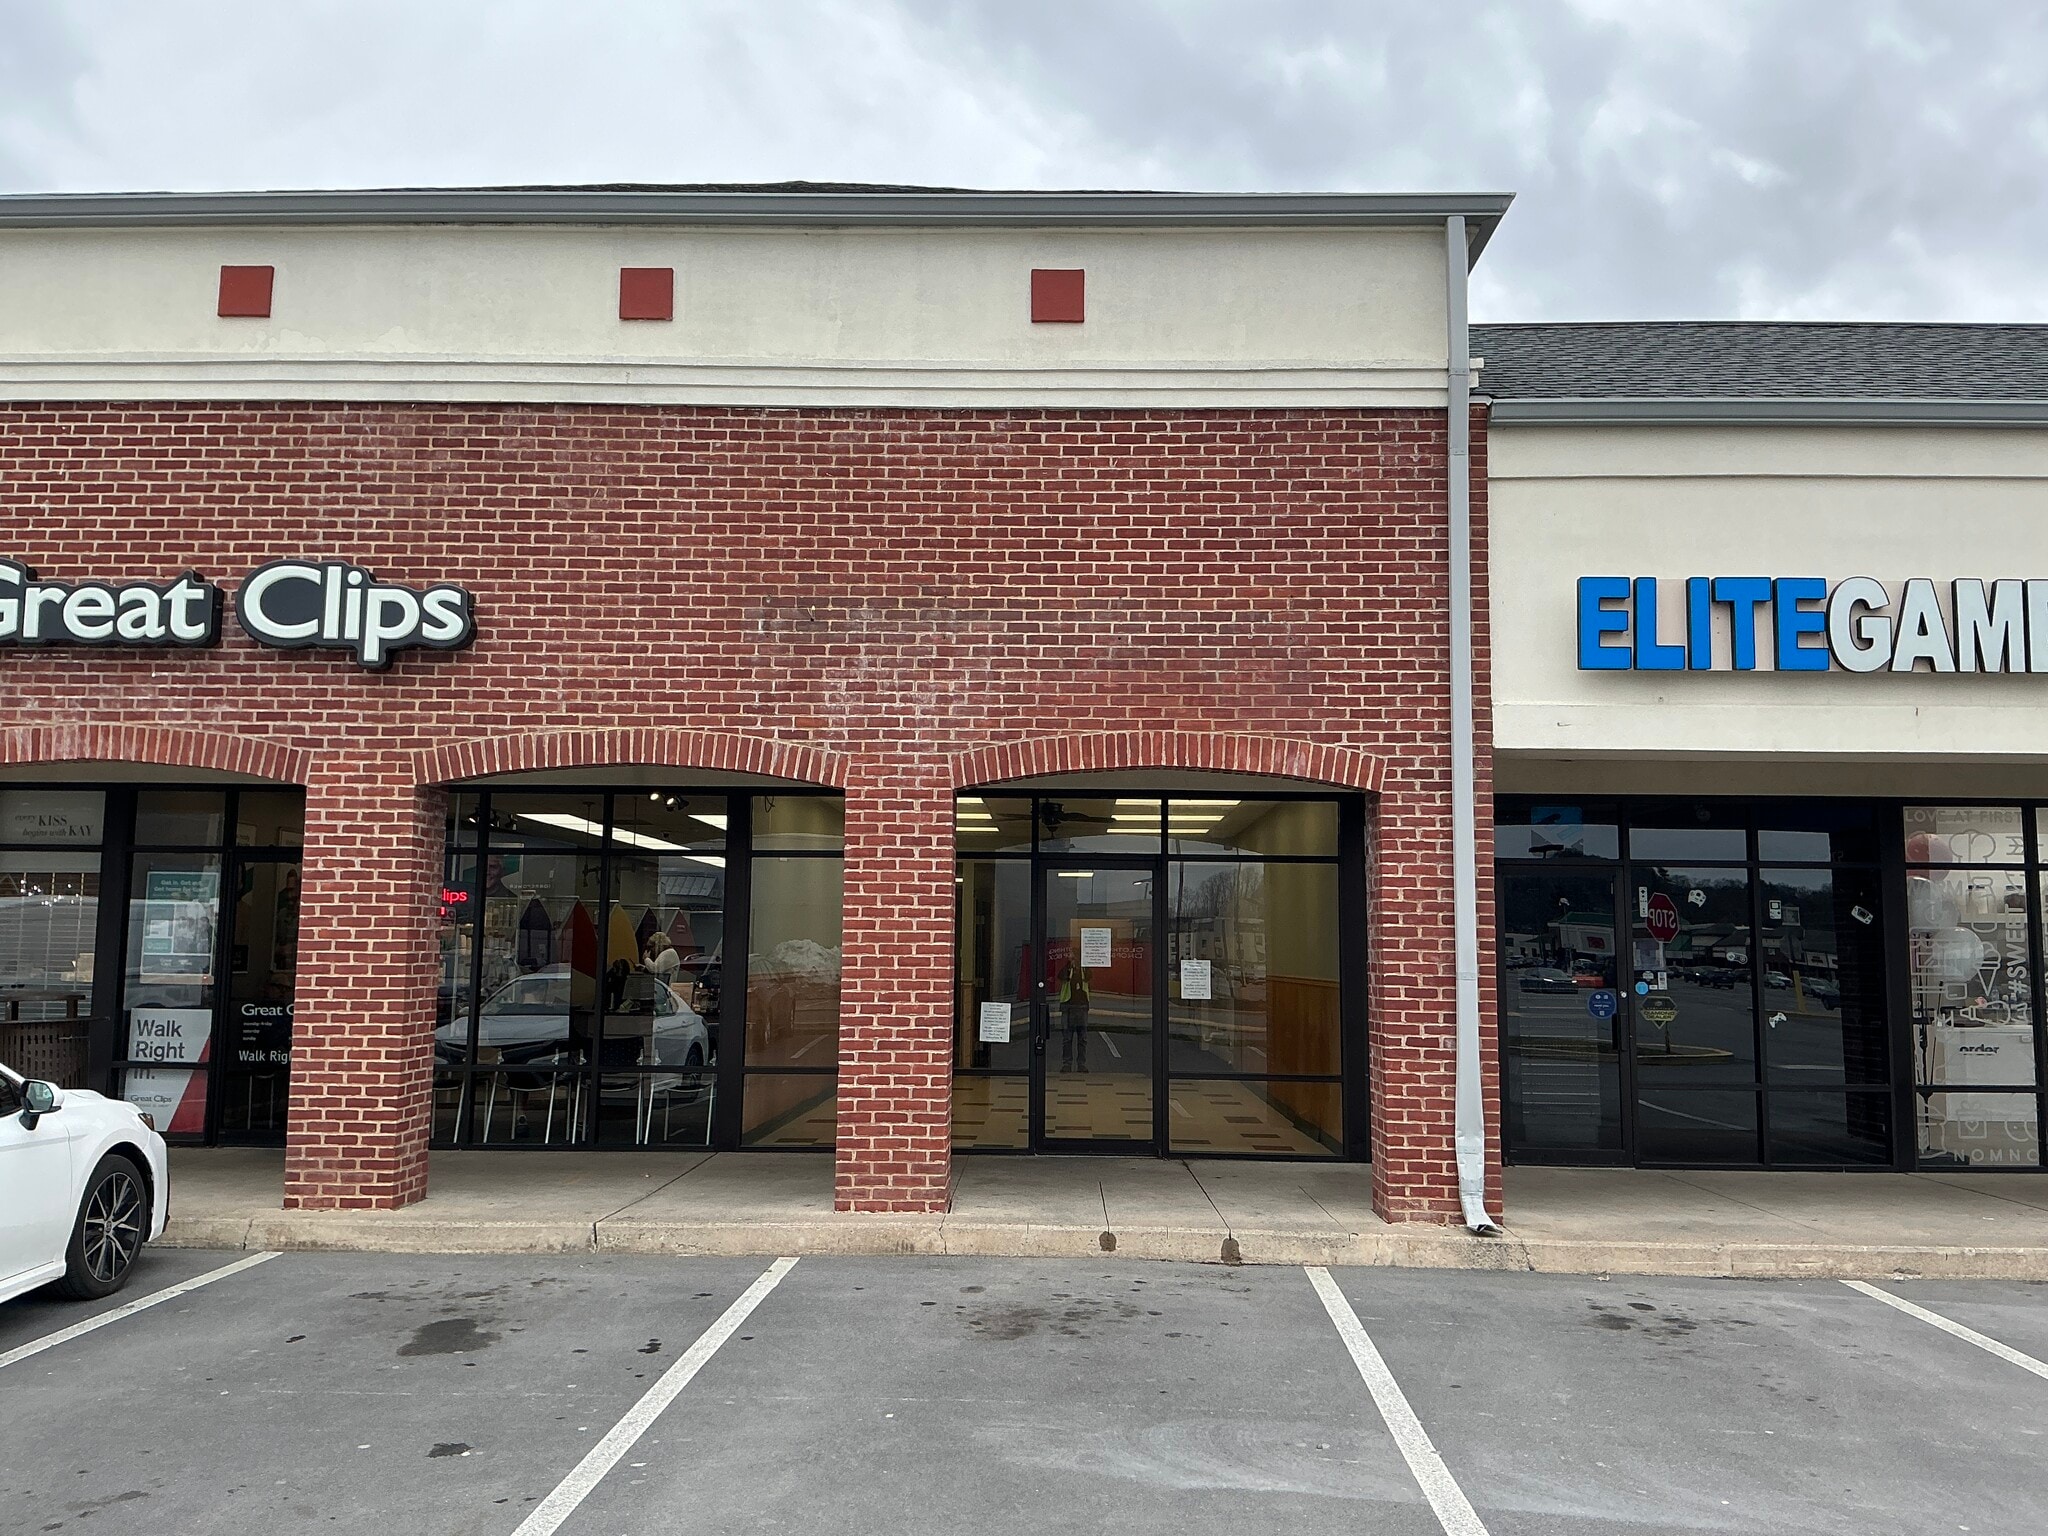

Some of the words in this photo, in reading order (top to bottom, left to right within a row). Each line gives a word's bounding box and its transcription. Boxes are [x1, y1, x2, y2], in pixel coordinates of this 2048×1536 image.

[0, 563, 206, 640] Great
[243, 564, 464, 663] Clips
[38, 814, 67, 826] KISS
[1904, 809, 1946, 822] LOVE
[1953, 810, 1973, 822] AT
[68, 824, 94, 836] KAY
[442, 888, 467, 904] lips
[2005, 903, 2029, 993] #SWEET
[241, 1003, 284, 1016] Great
[137, 1019, 182, 1038] Walk
[135, 1040, 185, 1061] Right
[238, 1050, 266, 1062] Walk
[270, 1050, 292, 1064] Rig
[130, 1094, 152, 1103] Great
[153, 1094, 172, 1104] Clips
